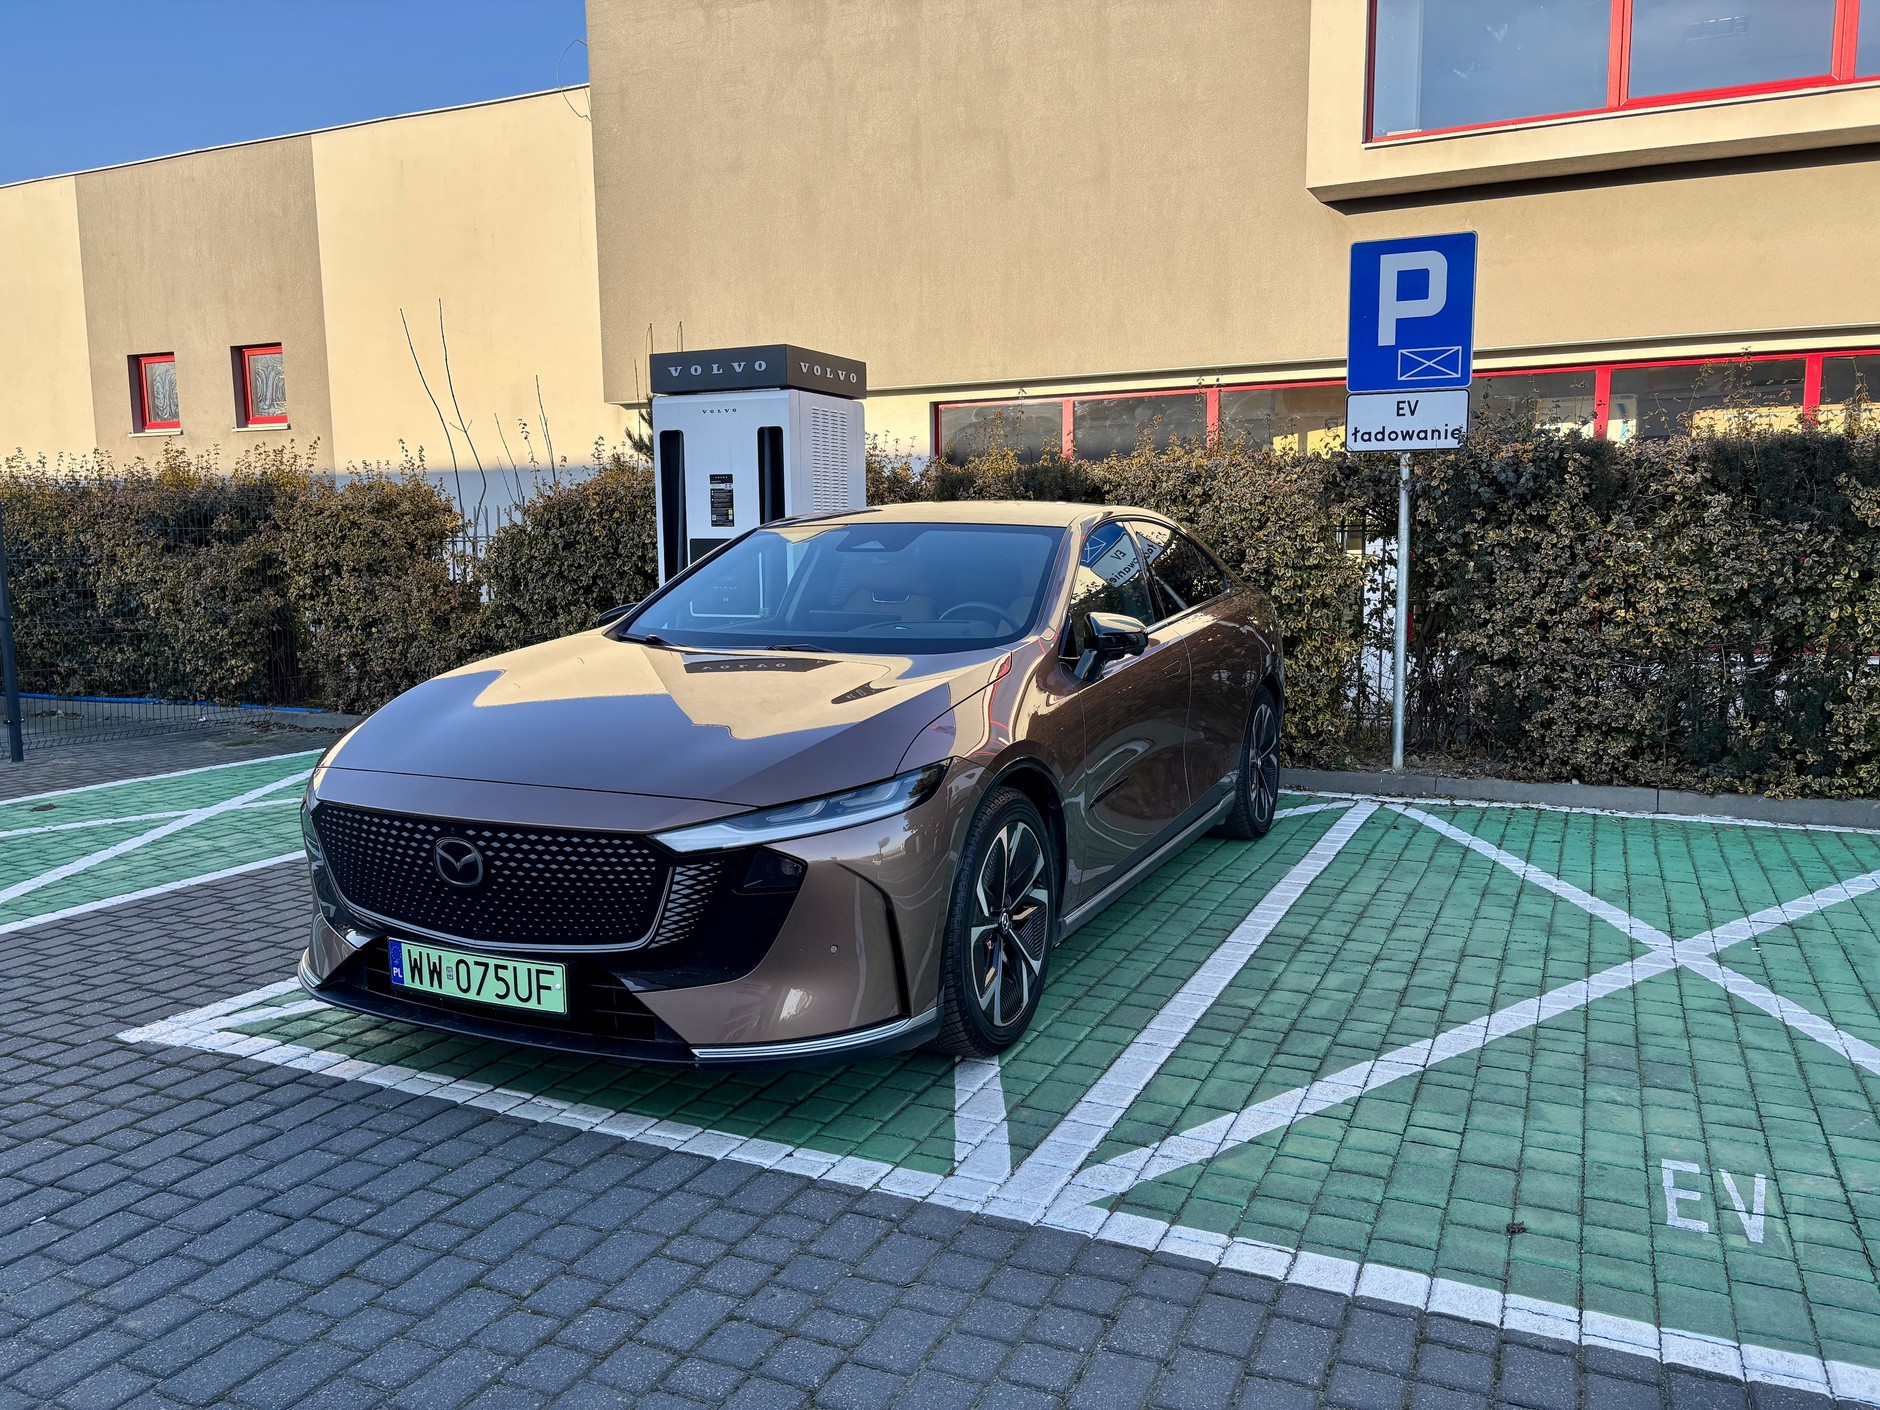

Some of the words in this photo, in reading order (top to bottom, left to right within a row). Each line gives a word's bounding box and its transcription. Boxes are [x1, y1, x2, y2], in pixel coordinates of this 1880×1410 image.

[1377, 250, 1448, 346] P
[667, 360, 767, 377] VOLVO
[799, 361, 857, 383] VOLVO
[1396, 400, 1419, 417] EV
[1351, 423, 1463, 443] ładowanie
[393, 967, 403, 978] PL
[407, 948, 443, 990] WW
[455, 958, 555, 1006] 075UF
[1661, 1158, 1767, 1244] EV
